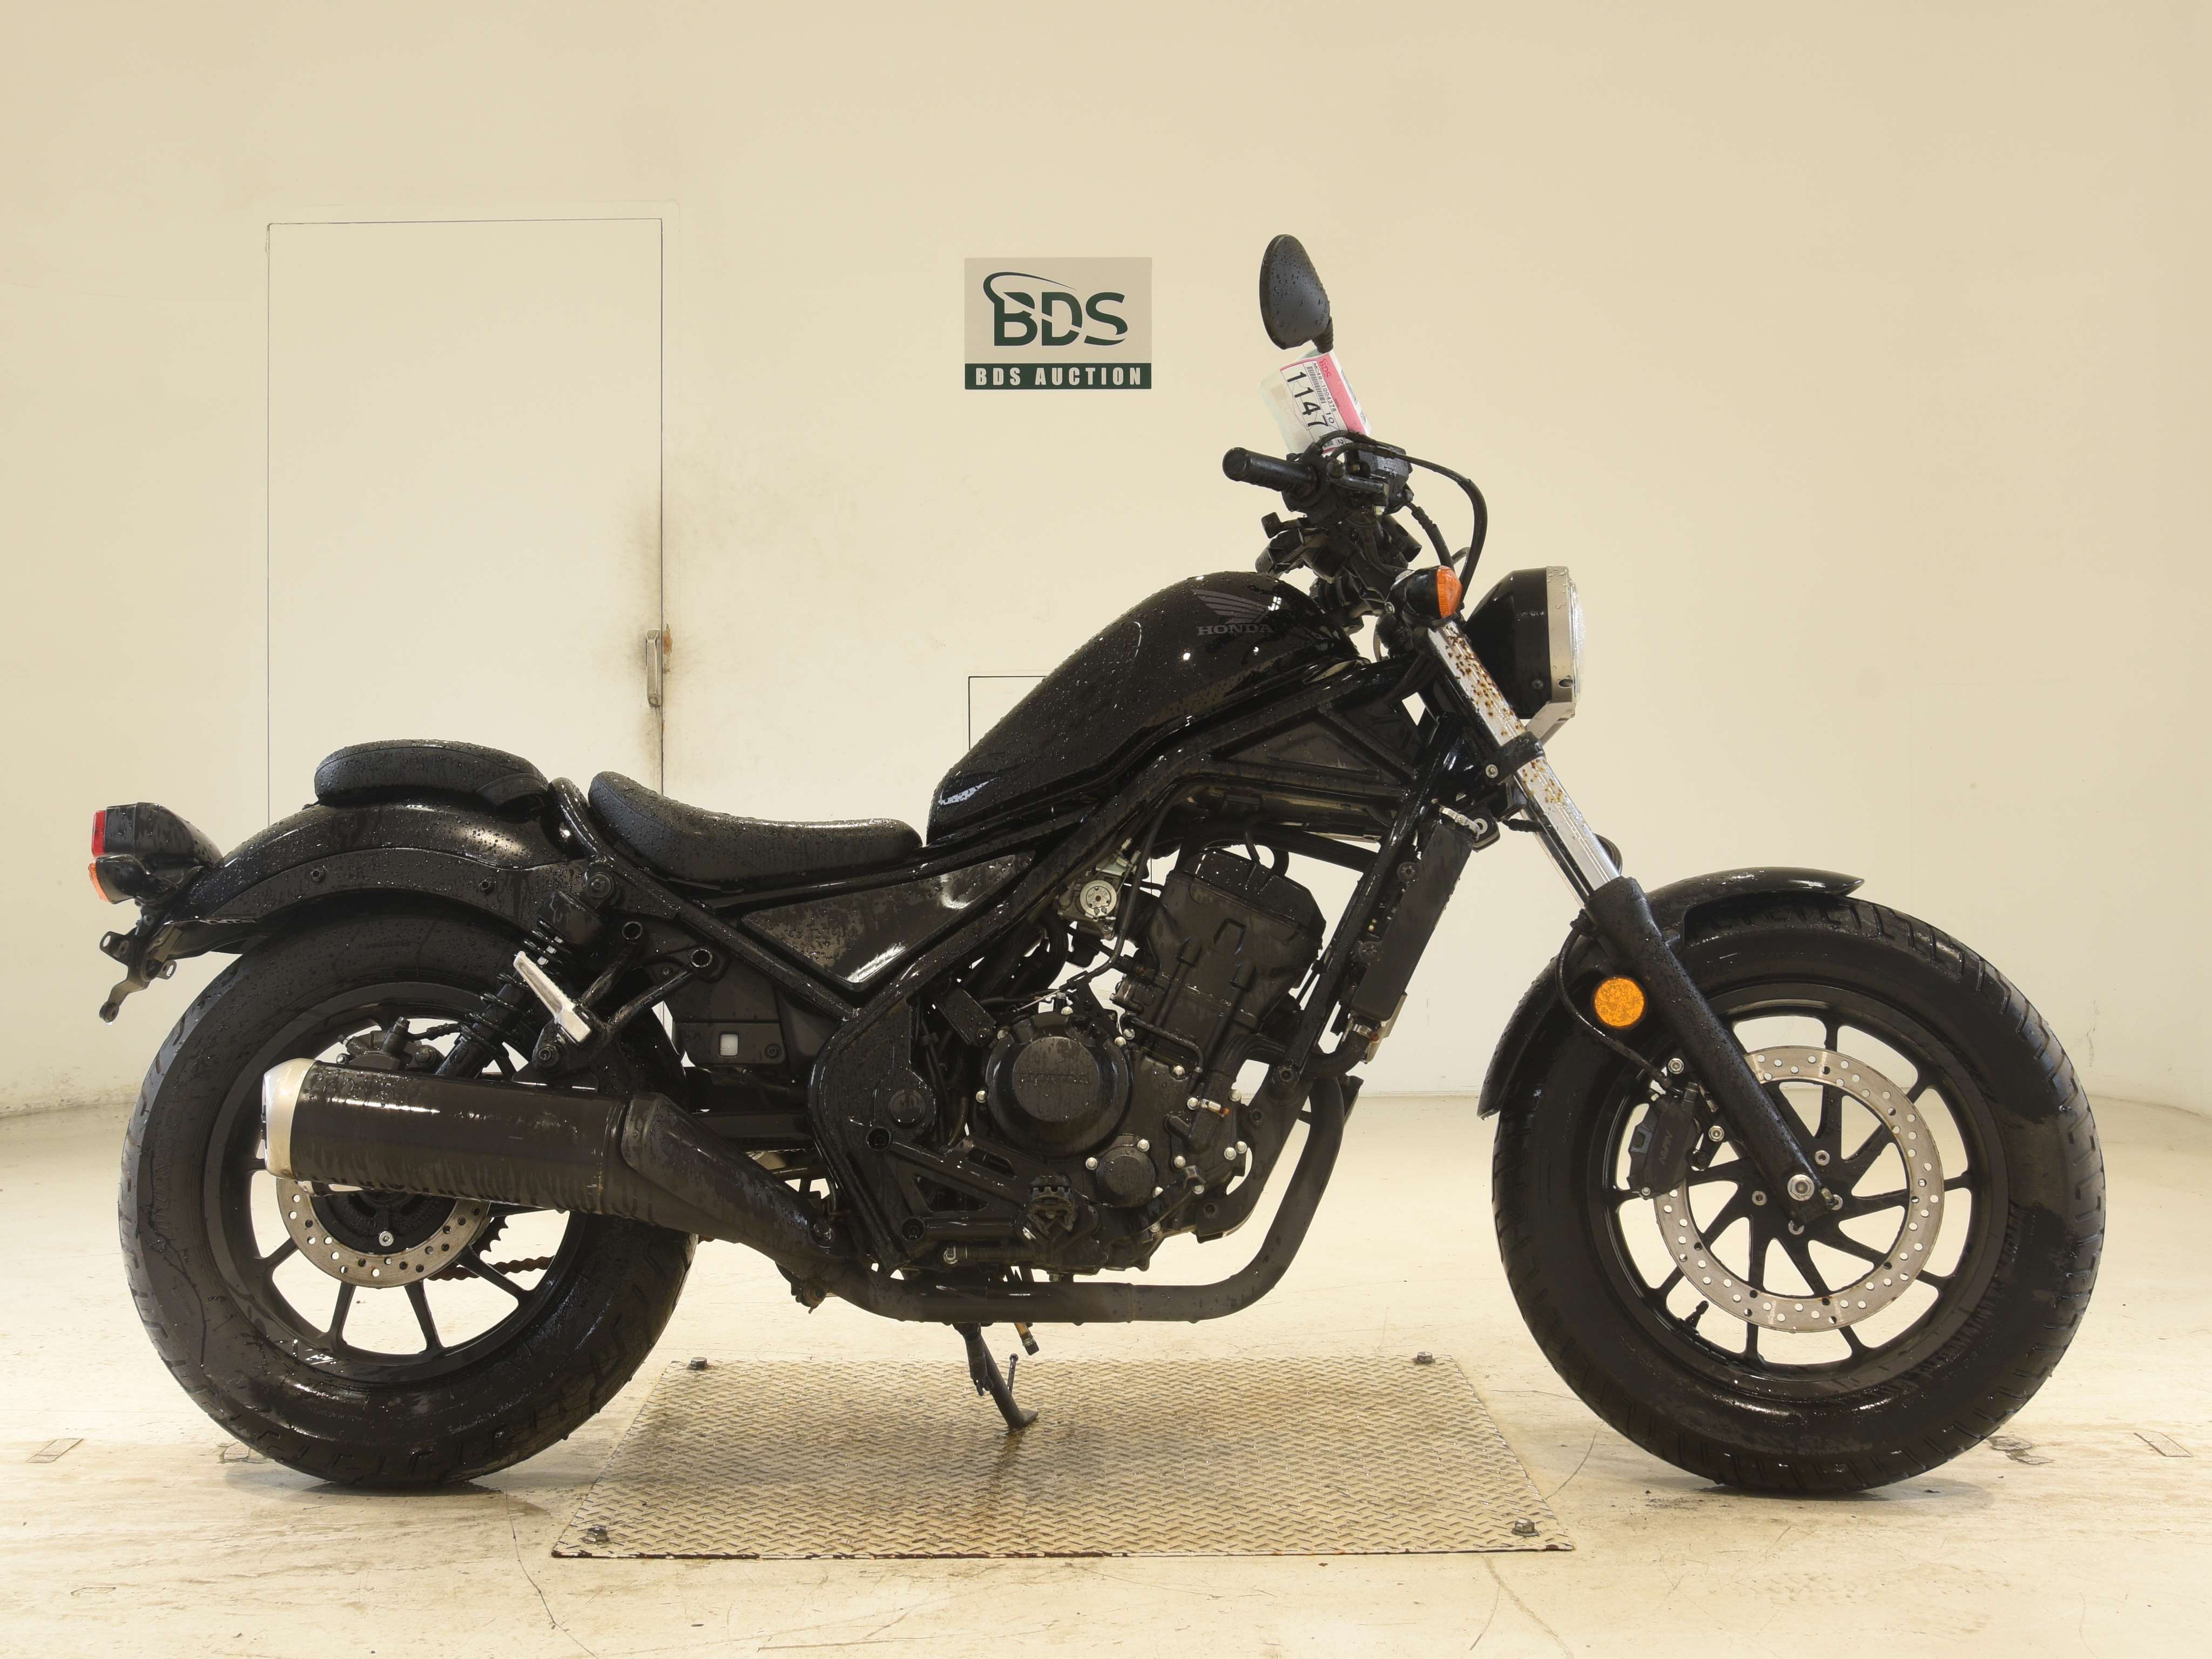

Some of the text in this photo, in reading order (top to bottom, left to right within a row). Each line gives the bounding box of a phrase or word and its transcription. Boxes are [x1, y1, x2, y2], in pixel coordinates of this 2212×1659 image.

[983, 272, 1128, 346] BDS
[975, 367, 1141, 386] BDS AUCTION
[1286, 372, 1329, 427] 1147
[1196, 623, 1274, 636] HONDA
